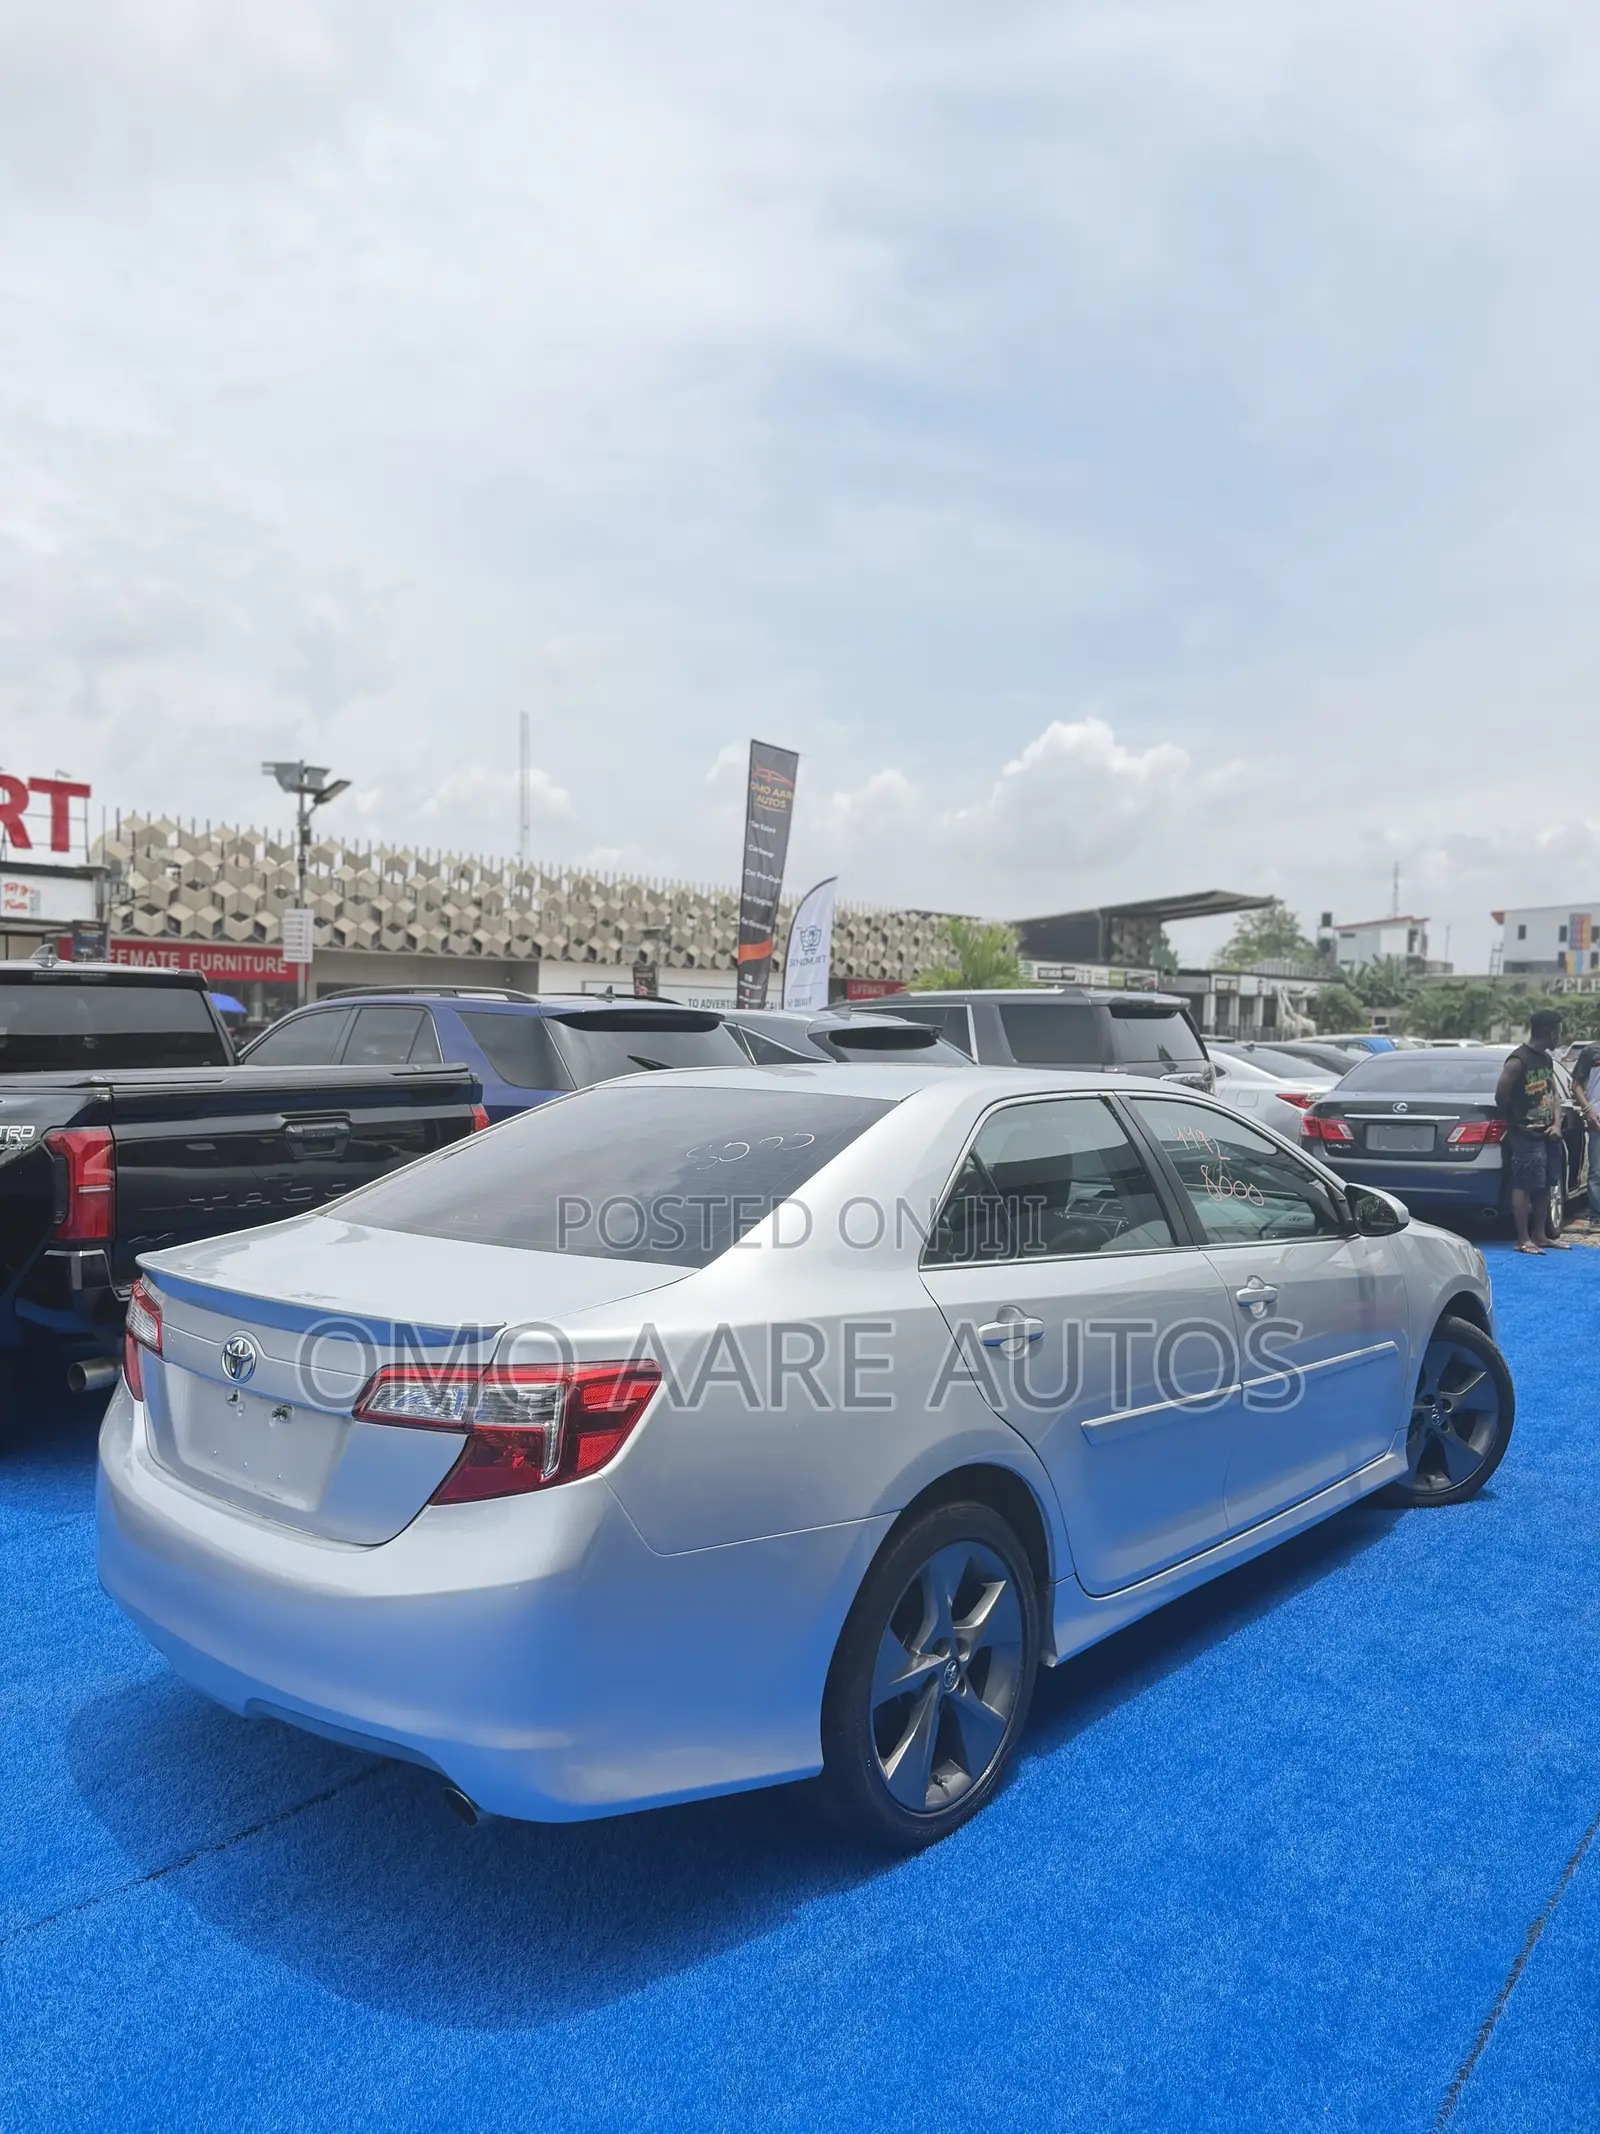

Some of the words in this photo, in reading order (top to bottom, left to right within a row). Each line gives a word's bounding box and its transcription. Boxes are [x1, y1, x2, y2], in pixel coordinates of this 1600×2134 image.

[750, 781, 771, 795] OMO
[772, 788, 794, 800] AAR
[755, 795, 787, 808] AUTOS
[108, 948, 181, 970] FEMATE
[188, 952, 288, 974] FURNITURE
[688, 997, 699, 1008] TO
[700, 998, 738, 1010] ADVERTIS
[0, 1125, 36, 1141] TRD
[1200, 1164, 1265, 1207] 8000
